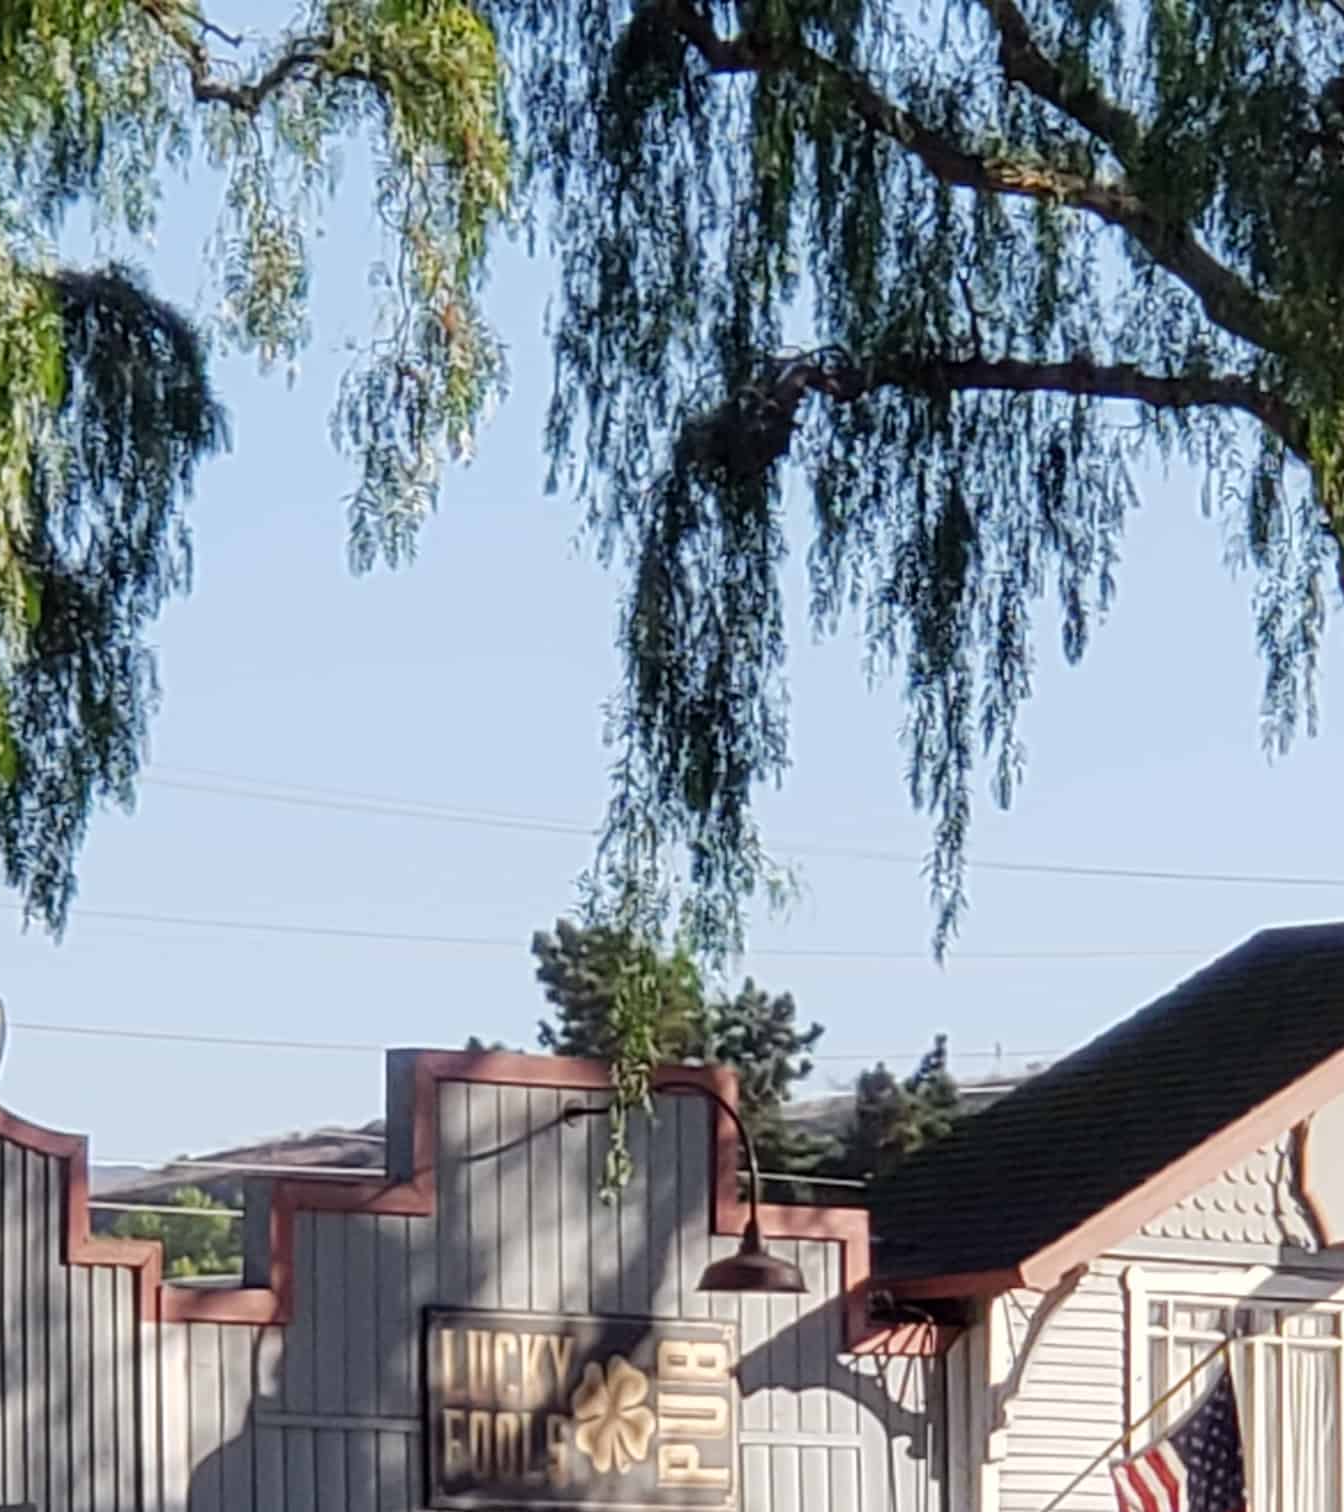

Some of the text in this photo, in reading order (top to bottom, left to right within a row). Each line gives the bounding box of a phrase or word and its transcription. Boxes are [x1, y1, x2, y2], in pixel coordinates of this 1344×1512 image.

[441, 1329, 575, 1407] LUCKY
[442, 1407, 575, 1488] FOOLS
[657, 1340, 730, 1488] PUB
